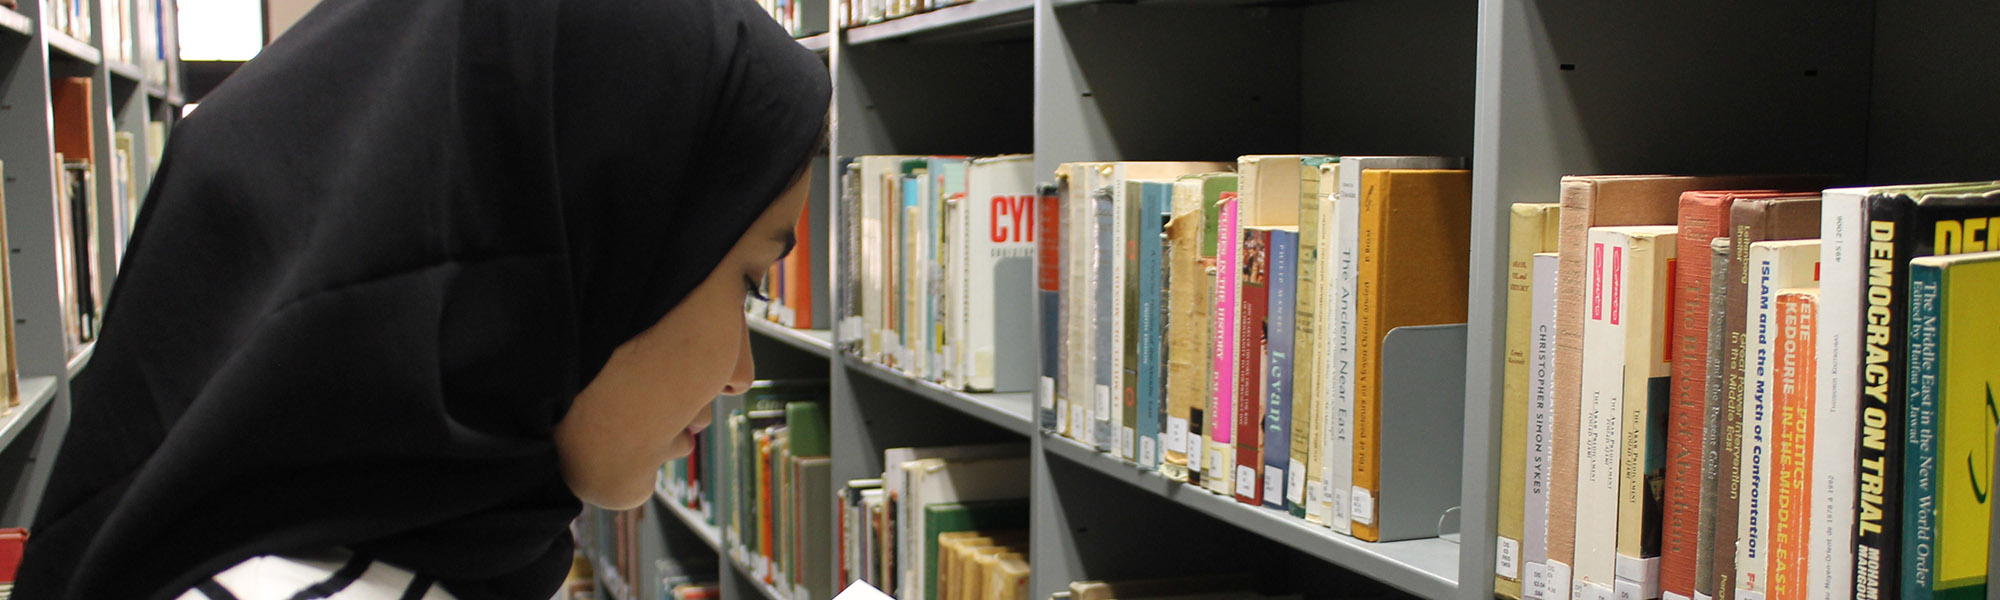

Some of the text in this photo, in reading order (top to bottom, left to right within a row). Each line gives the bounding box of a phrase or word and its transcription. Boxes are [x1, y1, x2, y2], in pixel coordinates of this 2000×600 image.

[1218, 276, 1226, 302] THE
[1219, 260, 1227, 274] IN
[1216, 308, 1225, 360] HISTORY
[1338, 248, 1351, 441] The Ancient Near East
[1783, 302, 1797, 395] KEDOURIE
[1800, 303, 1811, 341] ELIE
[1864, 220, 1895, 404] DEMOCRACY
[1268, 350, 1286, 433] Levant
[1712, 384, 1721, 401] the
[1713, 358, 1722, 379] and
[1728, 374, 1738, 422] Middle
[1731, 349, 1739, 370] the
[1908, 280, 1923, 445] Edited by Haifaa A. Jawad
[1533, 324, 1547, 494] CHRISTOPHER SIMON SYKES
[1671, 280, 1701, 552] The Blood of Abraham
[1710, 406, 1720, 446] Present
[1725, 425, 1734, 452] East
[1730, 333, 1746, 499] Great Power Intervention
[1749, 260, 1770, 558] ISLAM and the Myth of Confrontation
[1793, 407, 1808, 490] POLITICS
[1915, 281, 1938, 587] The Middle East in the New World Order
[1708, 450, 1718, 480] Crisis
[1775, 405, 1793, 596] IN THE MIDDLE EAST
[1859, 407, 1887, 537] ON TRIAL
